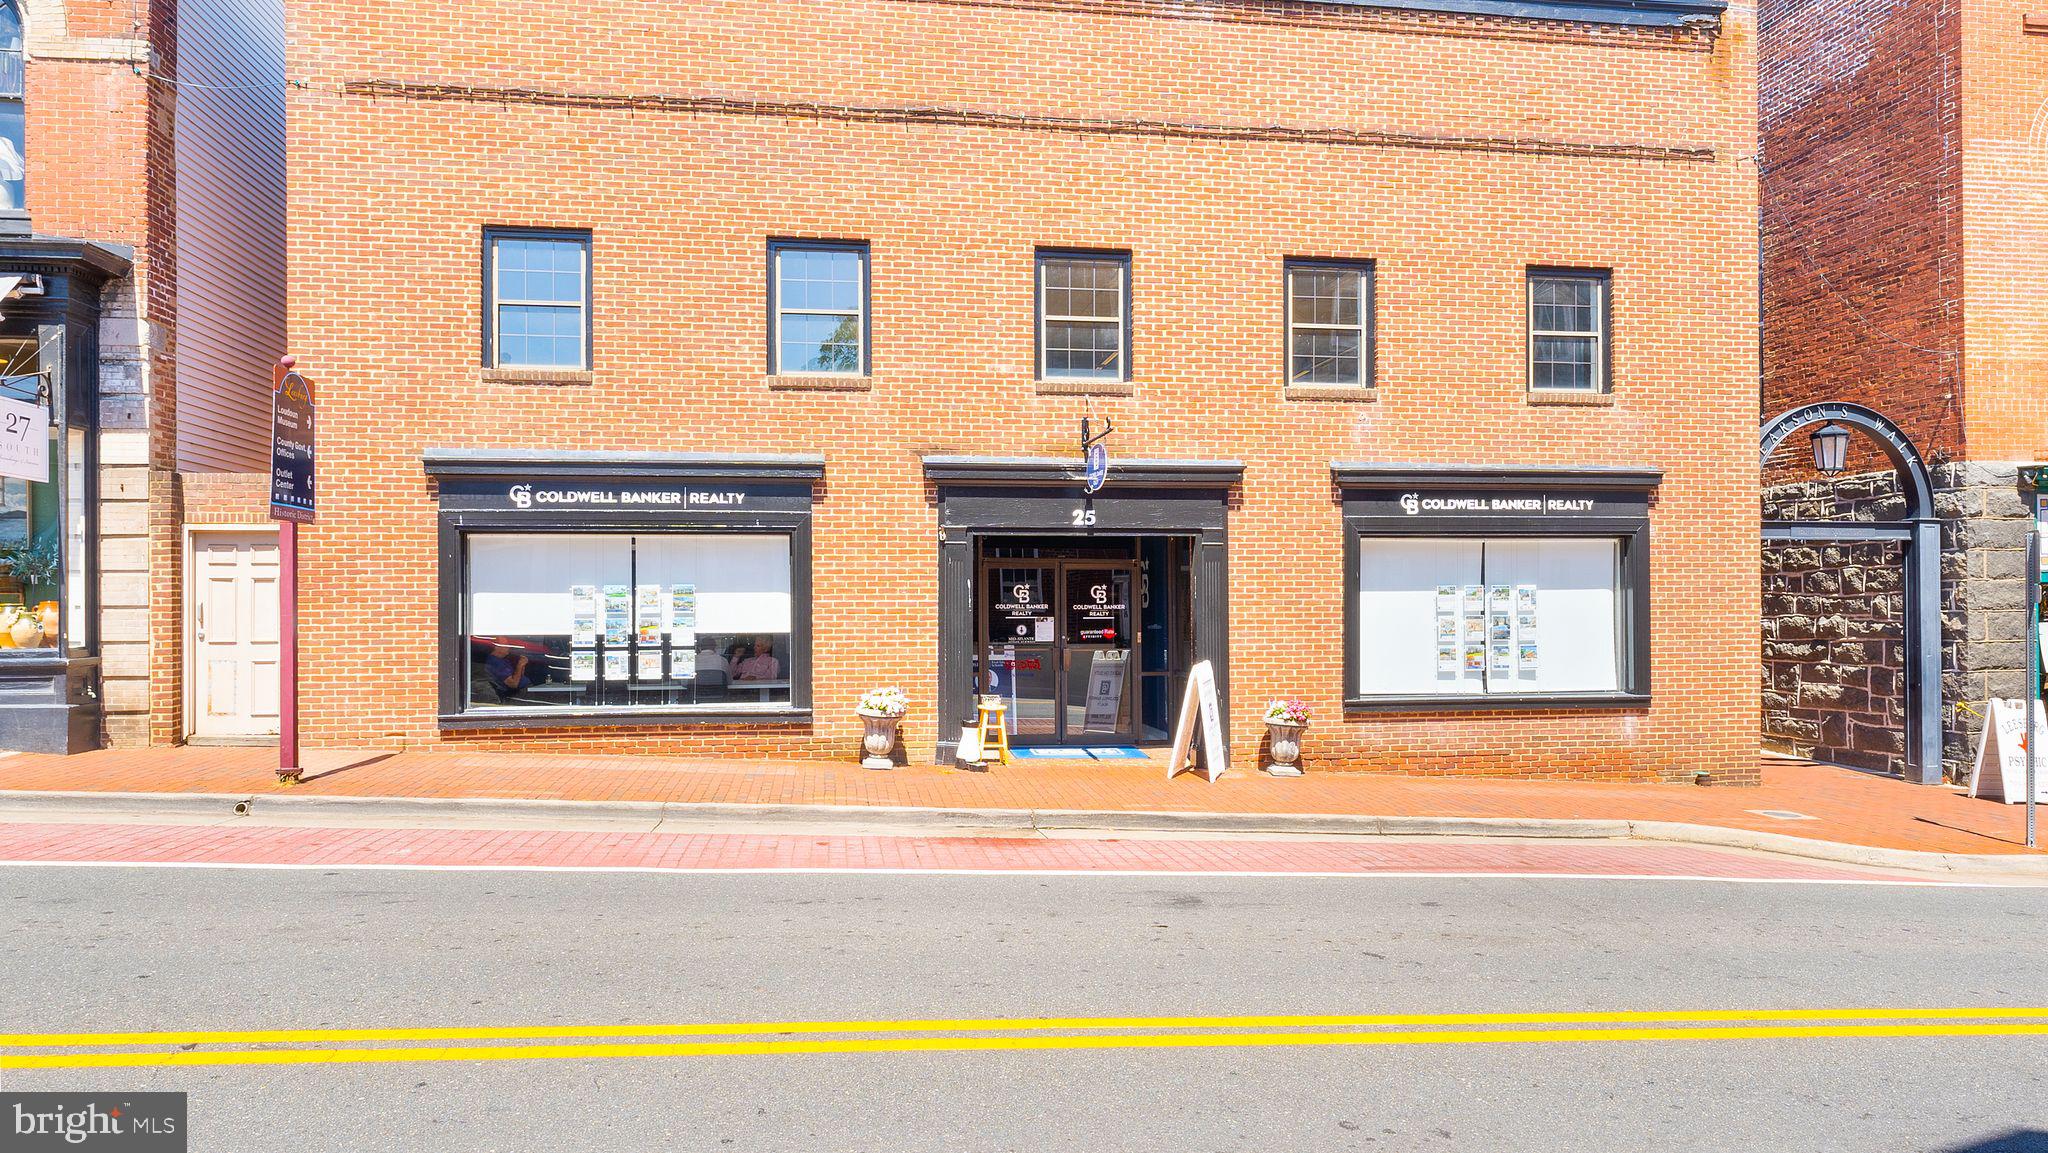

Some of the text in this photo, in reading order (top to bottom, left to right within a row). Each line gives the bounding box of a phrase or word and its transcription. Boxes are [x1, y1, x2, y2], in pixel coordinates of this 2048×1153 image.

[277, 405, 299, 419] Loudoun
[6, 412, 31, 441] 27
[277, 416, 298, 429] Museum
[1759, 404, 1918, 467] EARSON'S WALK
[276, 436, 295, 450] County
[276, 447, 295, 460] Offices
[275, 468, 293, 479] Outlet
[275, 479, 294, 490] Center
[535, 491, 618, 503] COLDWELL
[621, 491, 681, 504] BANKER
[689, 492, 746, 504] REALTY
[1421, 499, 1489, 510] COLDWELL
[1491, 499, 1542, 510] BANKER
[1547, 499, 1594, 511] REALTY
[274, 507, 314, 520] Historic District
[1072, 509, 1096, 526] 25
